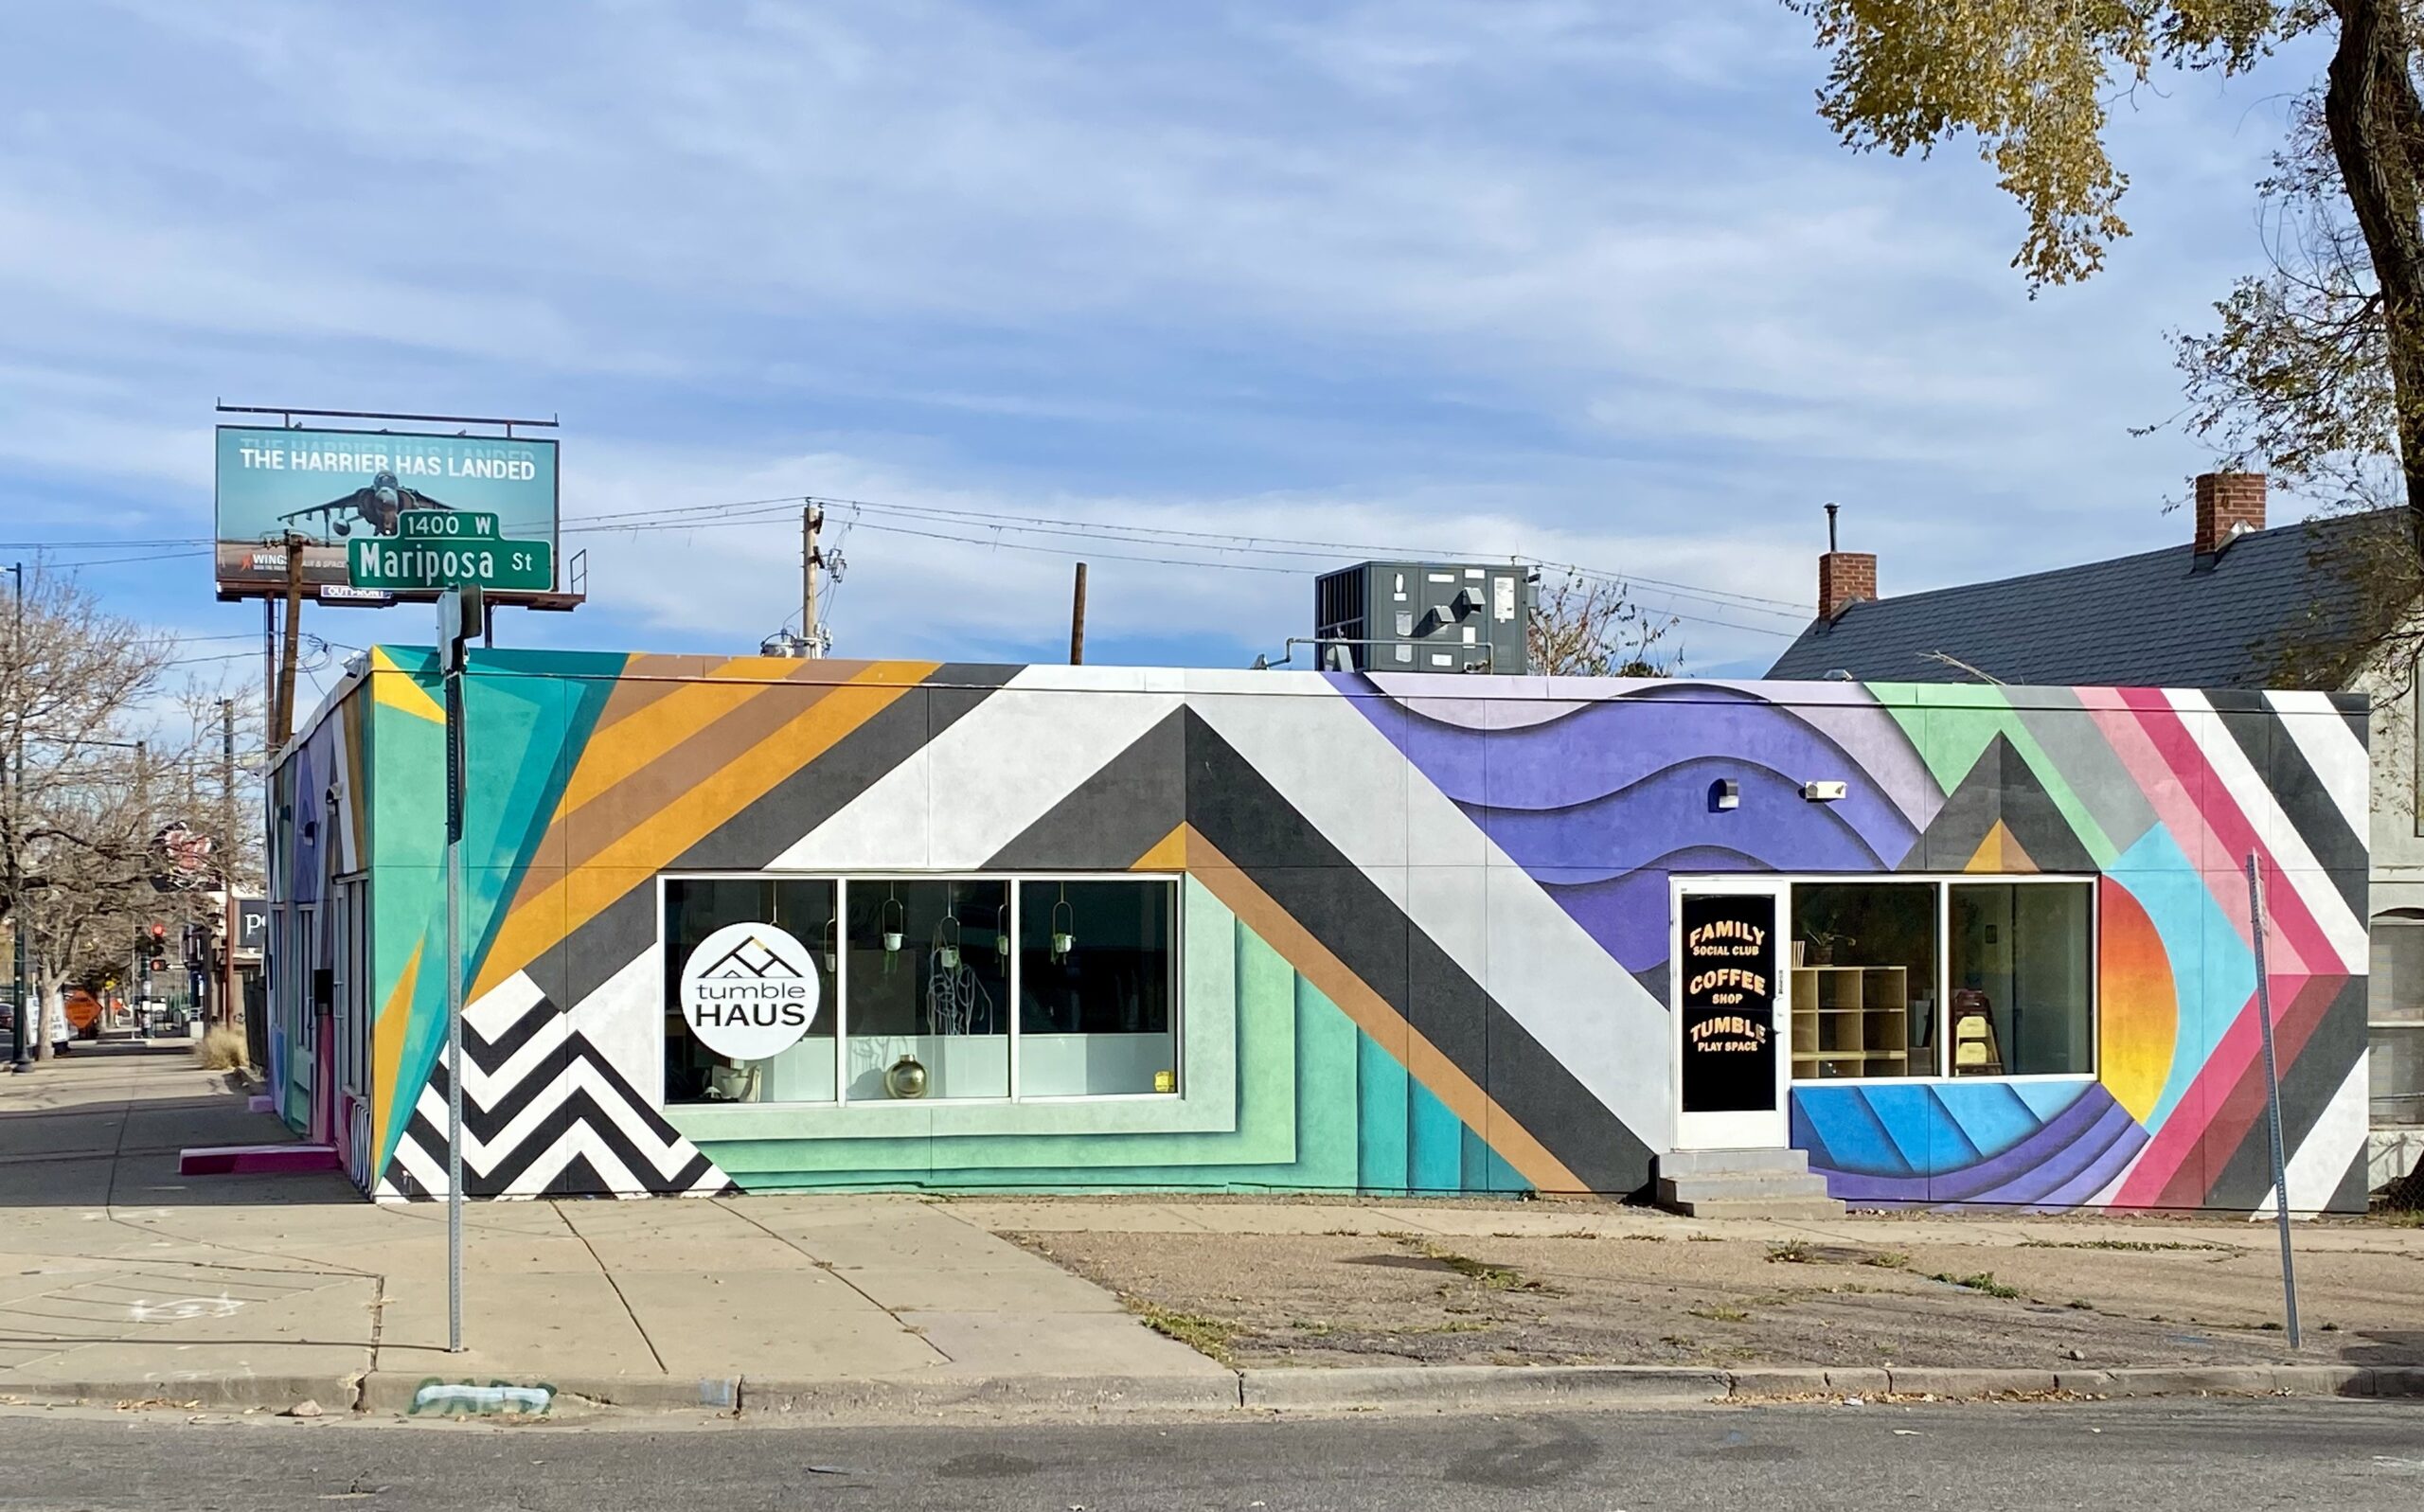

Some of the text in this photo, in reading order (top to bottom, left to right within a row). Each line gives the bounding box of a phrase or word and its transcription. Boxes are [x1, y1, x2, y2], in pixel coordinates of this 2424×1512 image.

[240, 448, 535, 480] THE HARRIER HAS LANDED
[408, 516, 490, 535] 1400 W
[360, 543, 533, 586] Mariposa St
[1689, 920, 1765, 948] FAMILY
[1693, 946, 1759, 956] SOCIAL CLUB
[696, 982, 806, 1000] tumble
[1689, 969, 1766, 996] COFFEE
[1712, 993, 1743, 1005] SHOP
[696, 1003, 806, 1027] HAUS
[1690, 1016, 1766, 1044] TUMBLE
[1698, 1041, 1758, 1052] PLAY SPACE
